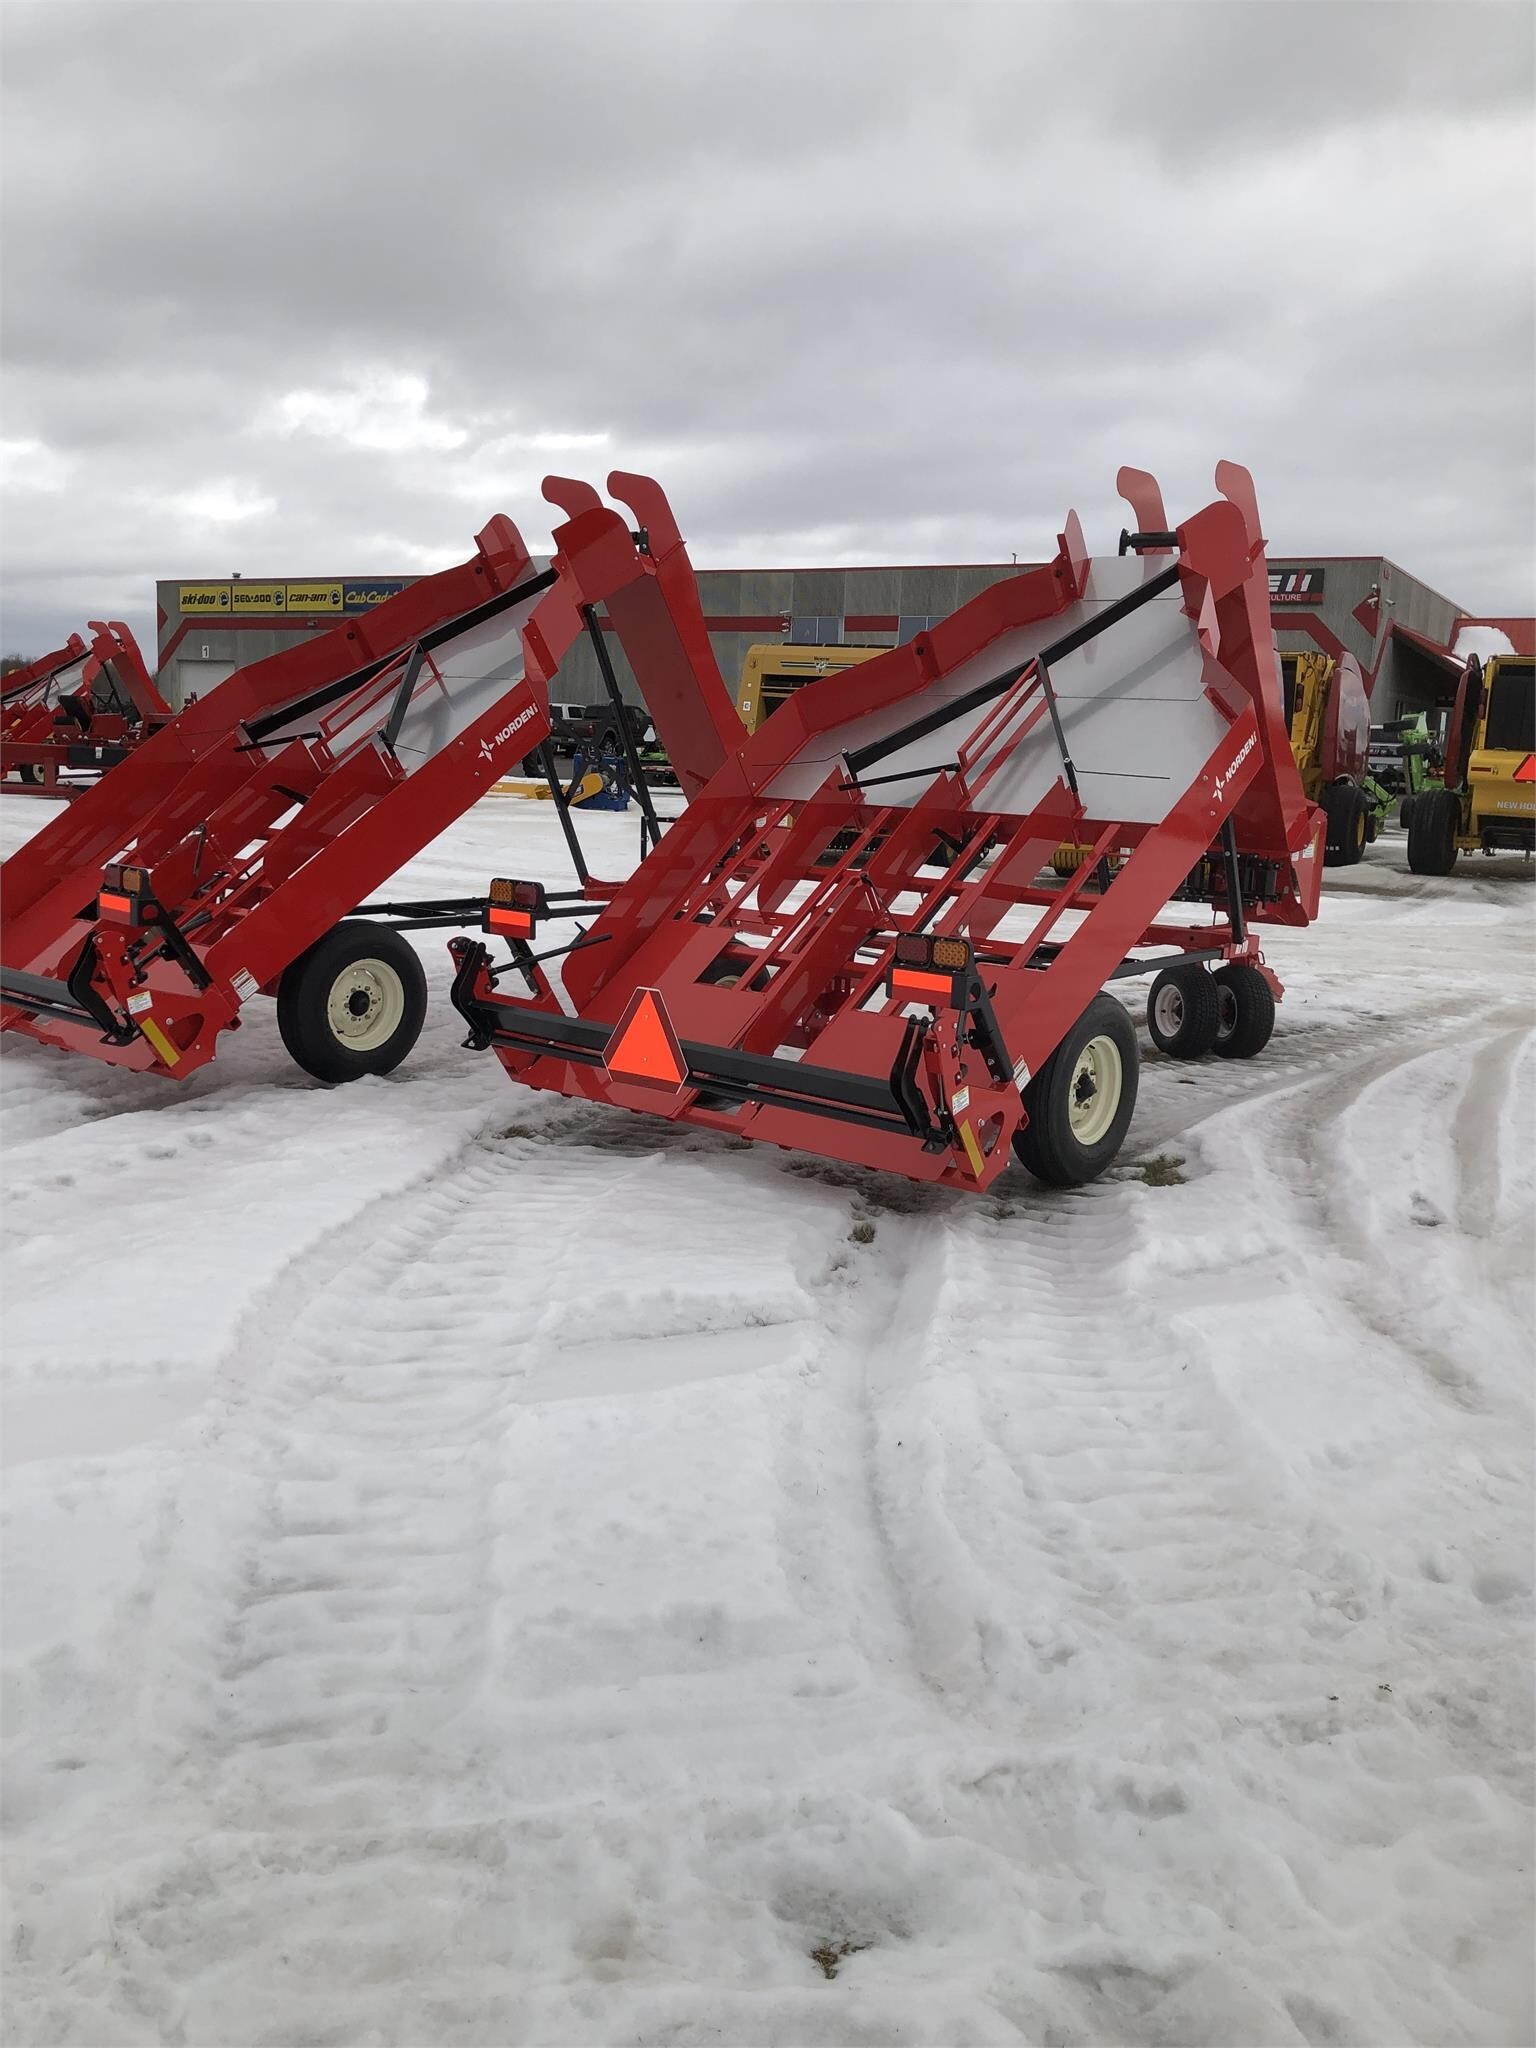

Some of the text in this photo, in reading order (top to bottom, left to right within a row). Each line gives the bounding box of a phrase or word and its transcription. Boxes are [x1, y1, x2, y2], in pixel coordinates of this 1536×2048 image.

[289, 593, 327, 602] can-am
[345, 591, 366, 604] Cub
[495, 705, 535, 745] NORDEN
[1225, 733, 1255, 782] NORDEN
